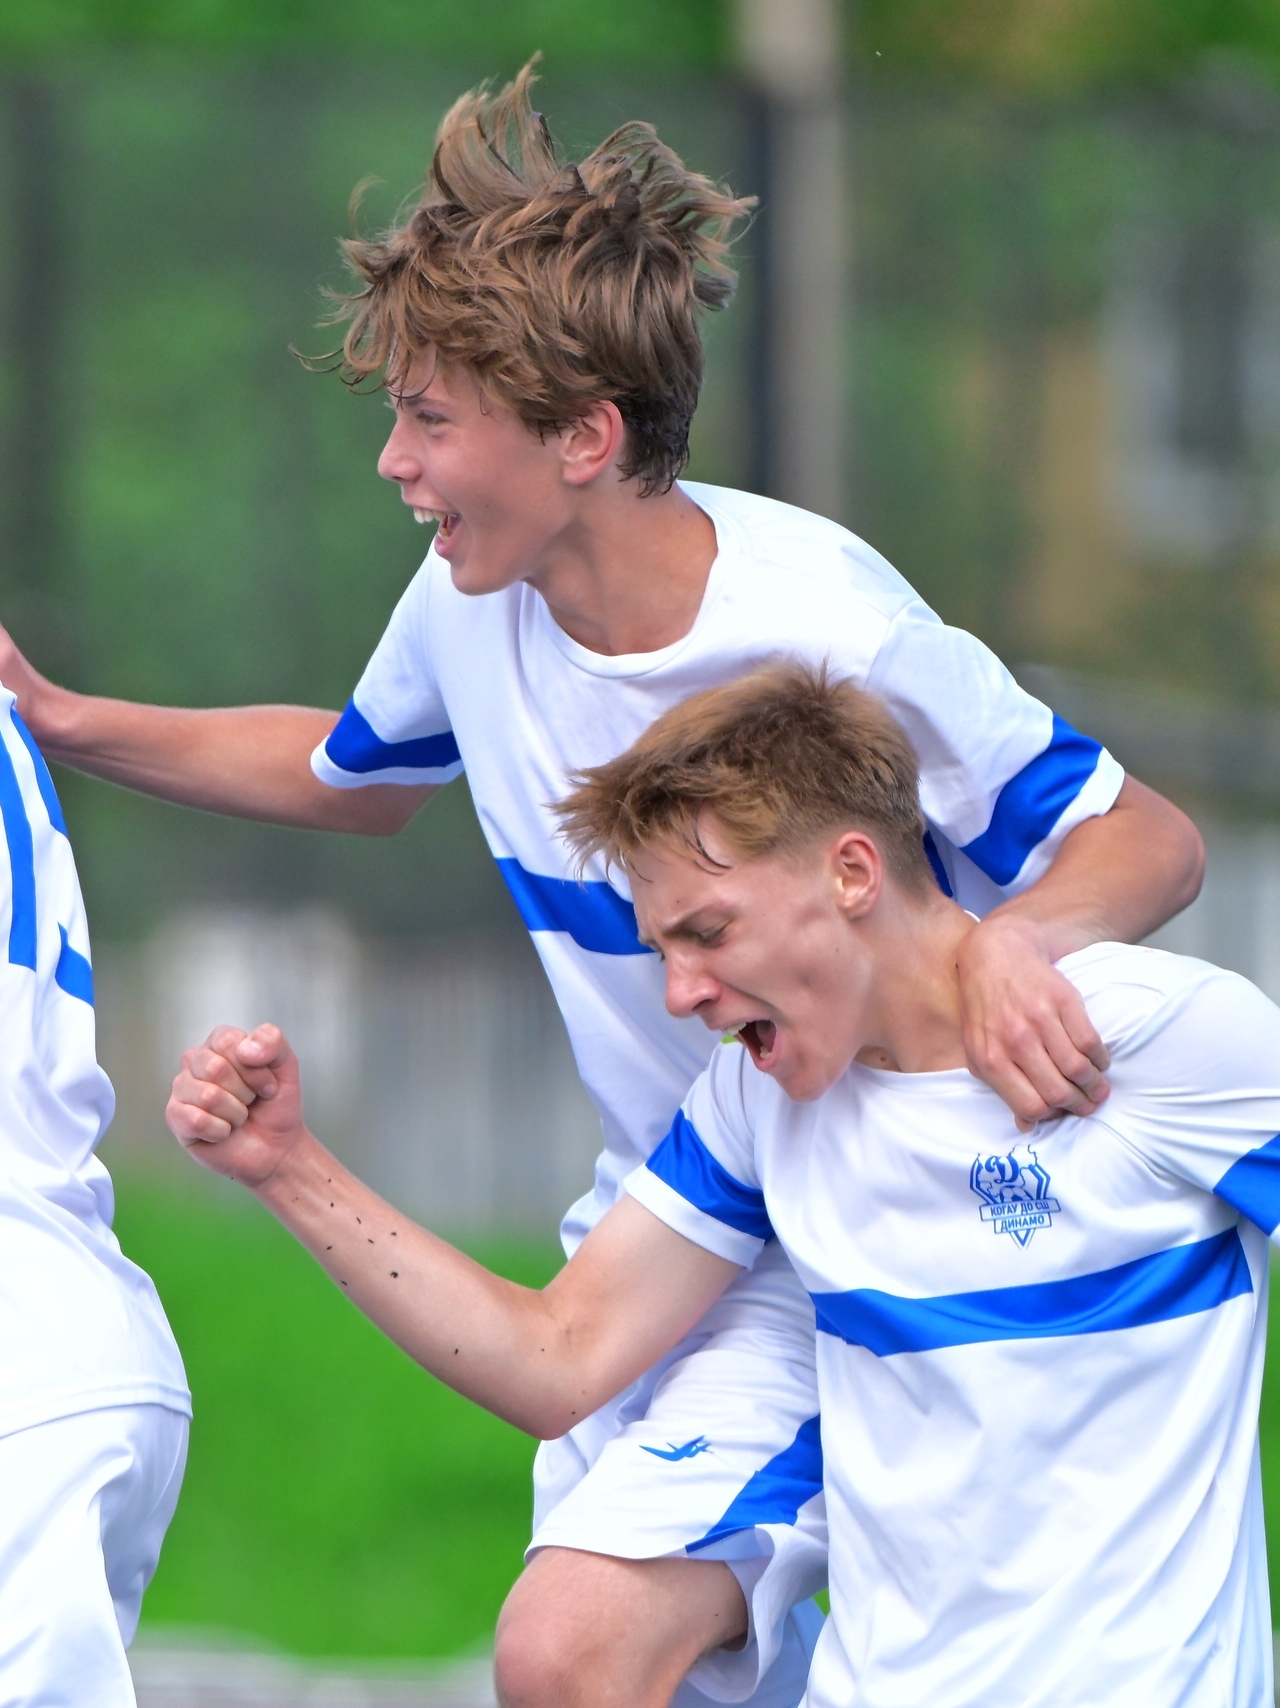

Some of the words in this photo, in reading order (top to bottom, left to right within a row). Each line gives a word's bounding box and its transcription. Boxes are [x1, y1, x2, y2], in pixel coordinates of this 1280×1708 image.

[990, 1203, 1018, 1217] КОГАУ
[1021, 1202, 1033, 1216] ДО
[1035, 1201, 1050, 1210] СШ
[1001, 1215, 1045, 1233] ДИНАМО
